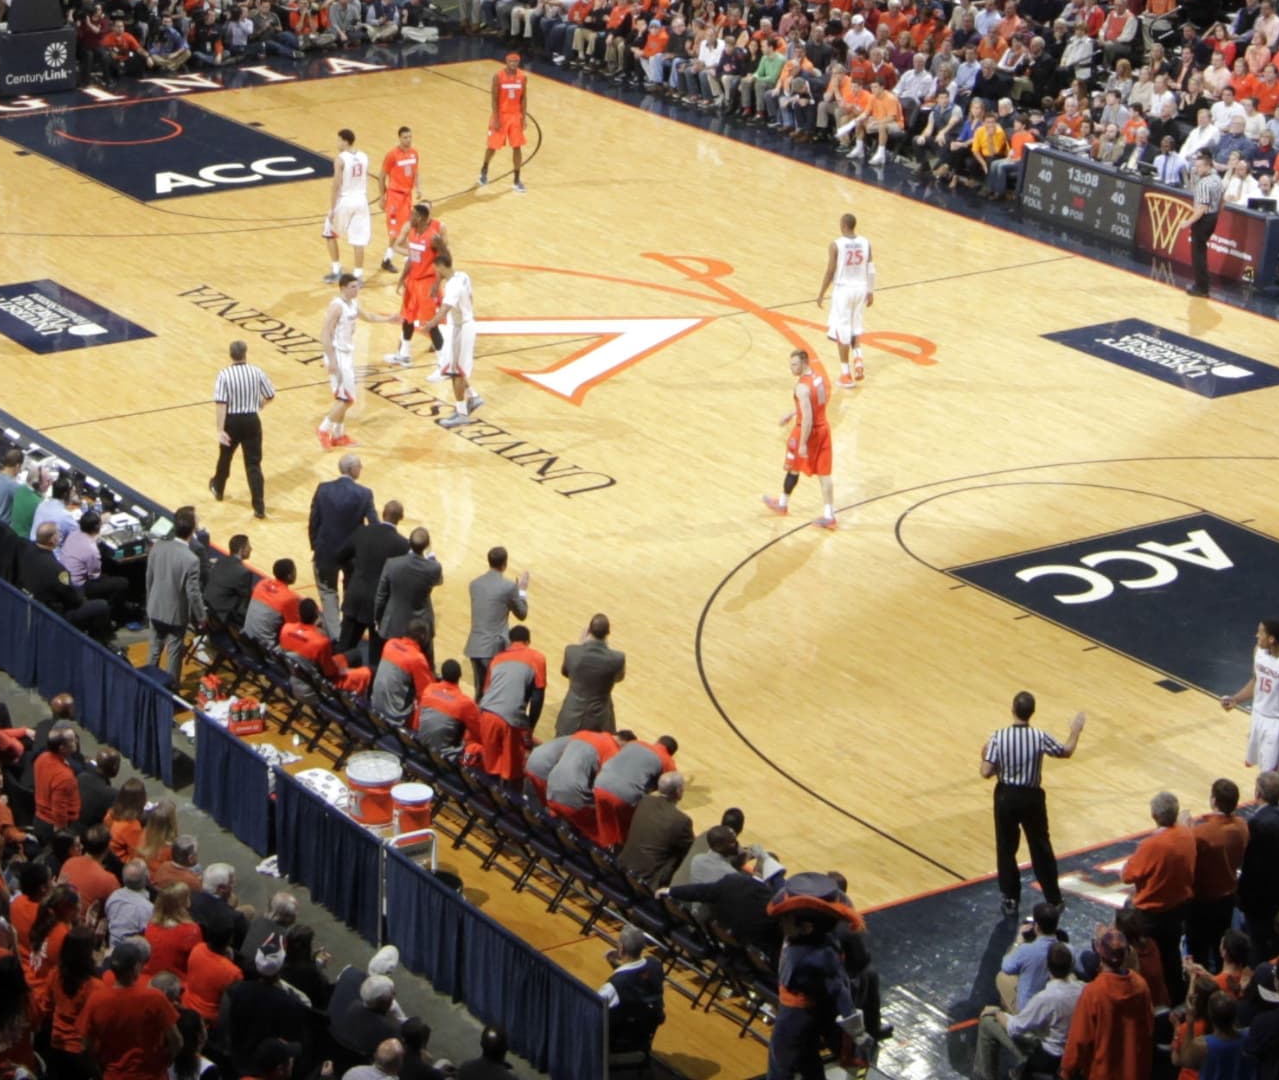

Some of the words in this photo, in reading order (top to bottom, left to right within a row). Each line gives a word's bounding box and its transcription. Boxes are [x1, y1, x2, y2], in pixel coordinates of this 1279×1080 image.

[6, 68, 68, 86] CenturyLink
[155, 156, 314, 194] ACC
[352, 165, 362, 178] 13
[1038, 169, 1052, 182] 40
[1068, 168, 1098, 188] 13:08
[1111, 192, 1126, 205] 40
[846, 250, 864, 266] 25
[1015, 528, 1234, 605] ACC
[1260, 678, 1272, 693] 15
